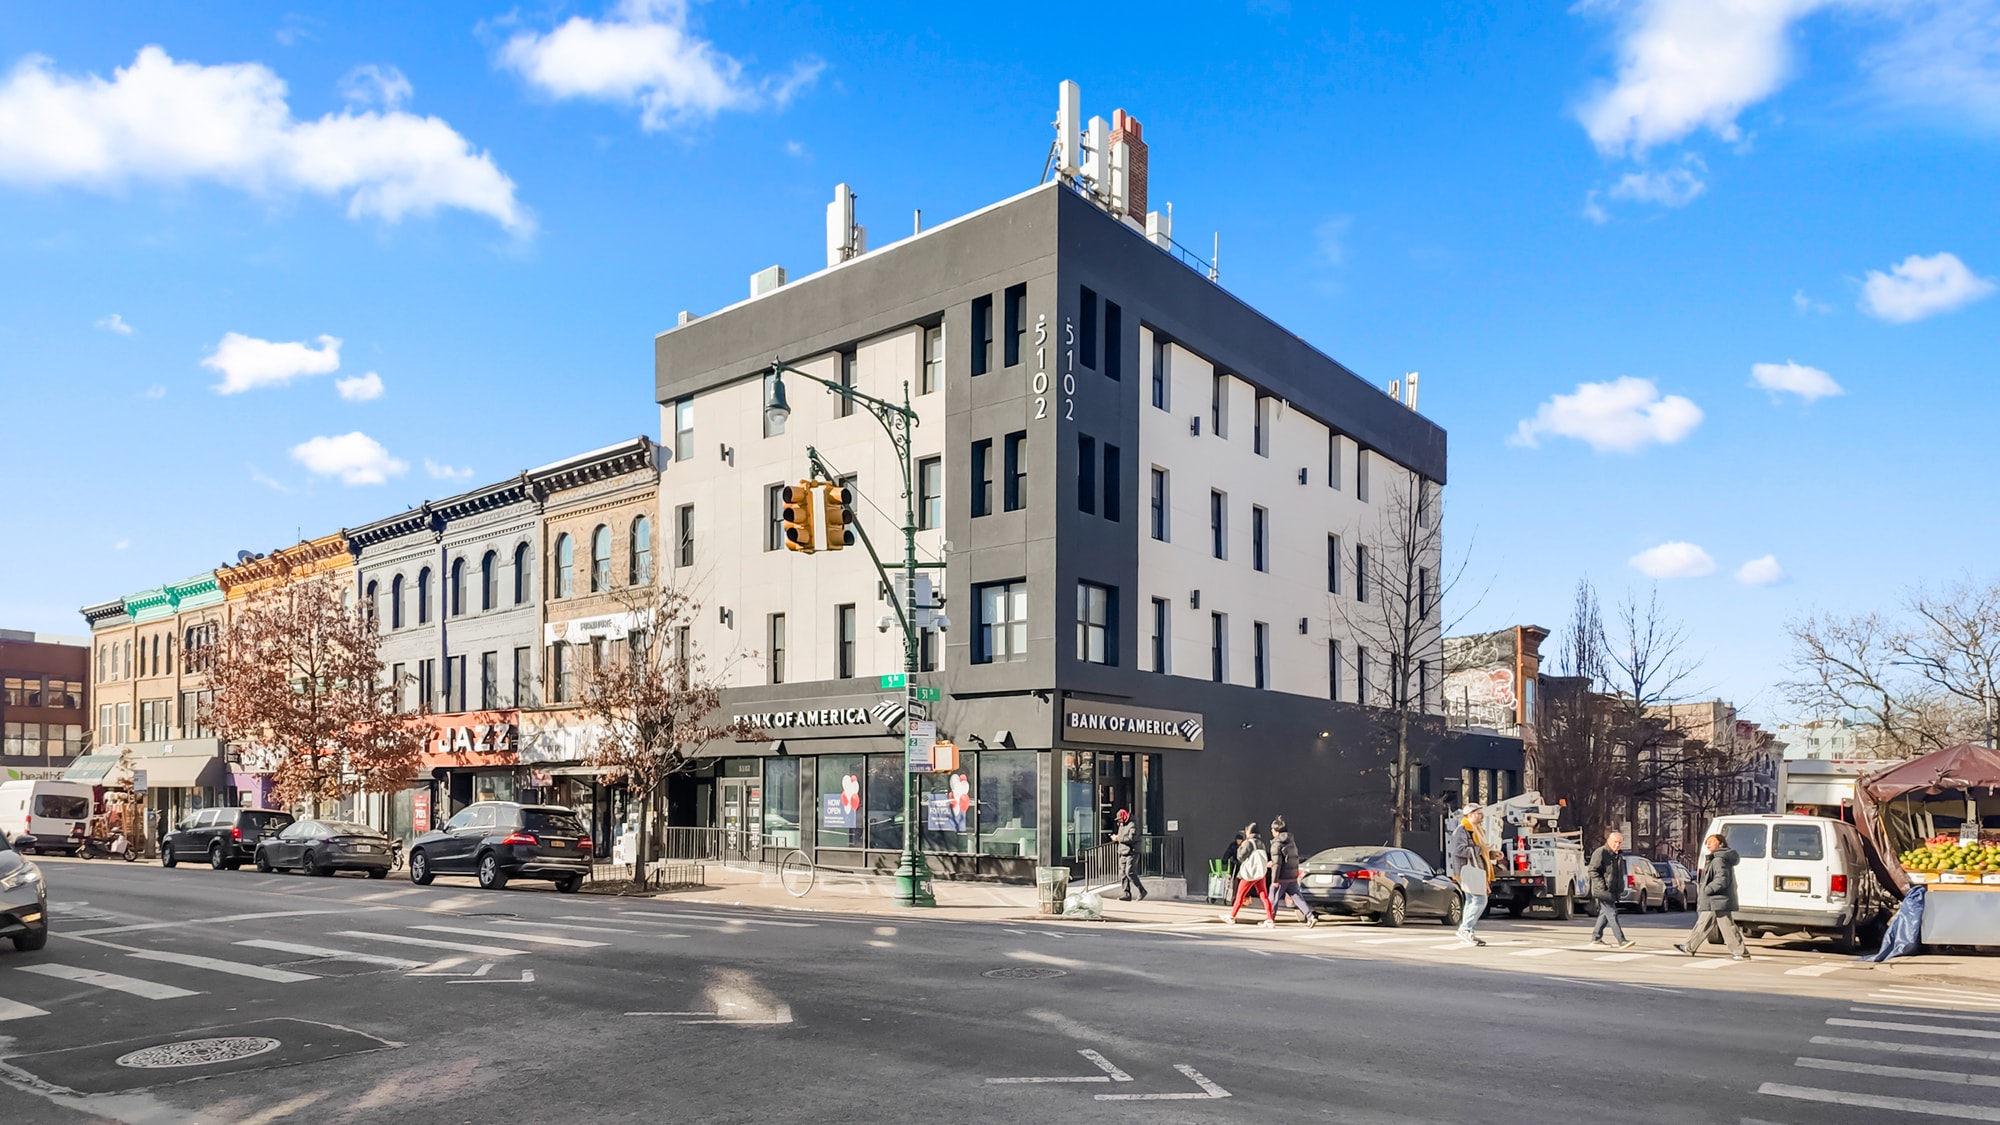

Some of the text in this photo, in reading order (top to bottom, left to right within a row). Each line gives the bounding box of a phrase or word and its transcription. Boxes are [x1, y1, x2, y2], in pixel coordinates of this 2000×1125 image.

[1033, 322, 1048, 420] 5102
[1064, 323, 1075, 421] 5102
[922, 689, 928, 699] 51
[733, 707, 867, 729] BANK OF AMERICA
[1071, 712, 1180, 736] BANK OF AMERICA
[438, 724, 511, 753] JAZZ
[827, 807, 841, 815] OPEN
